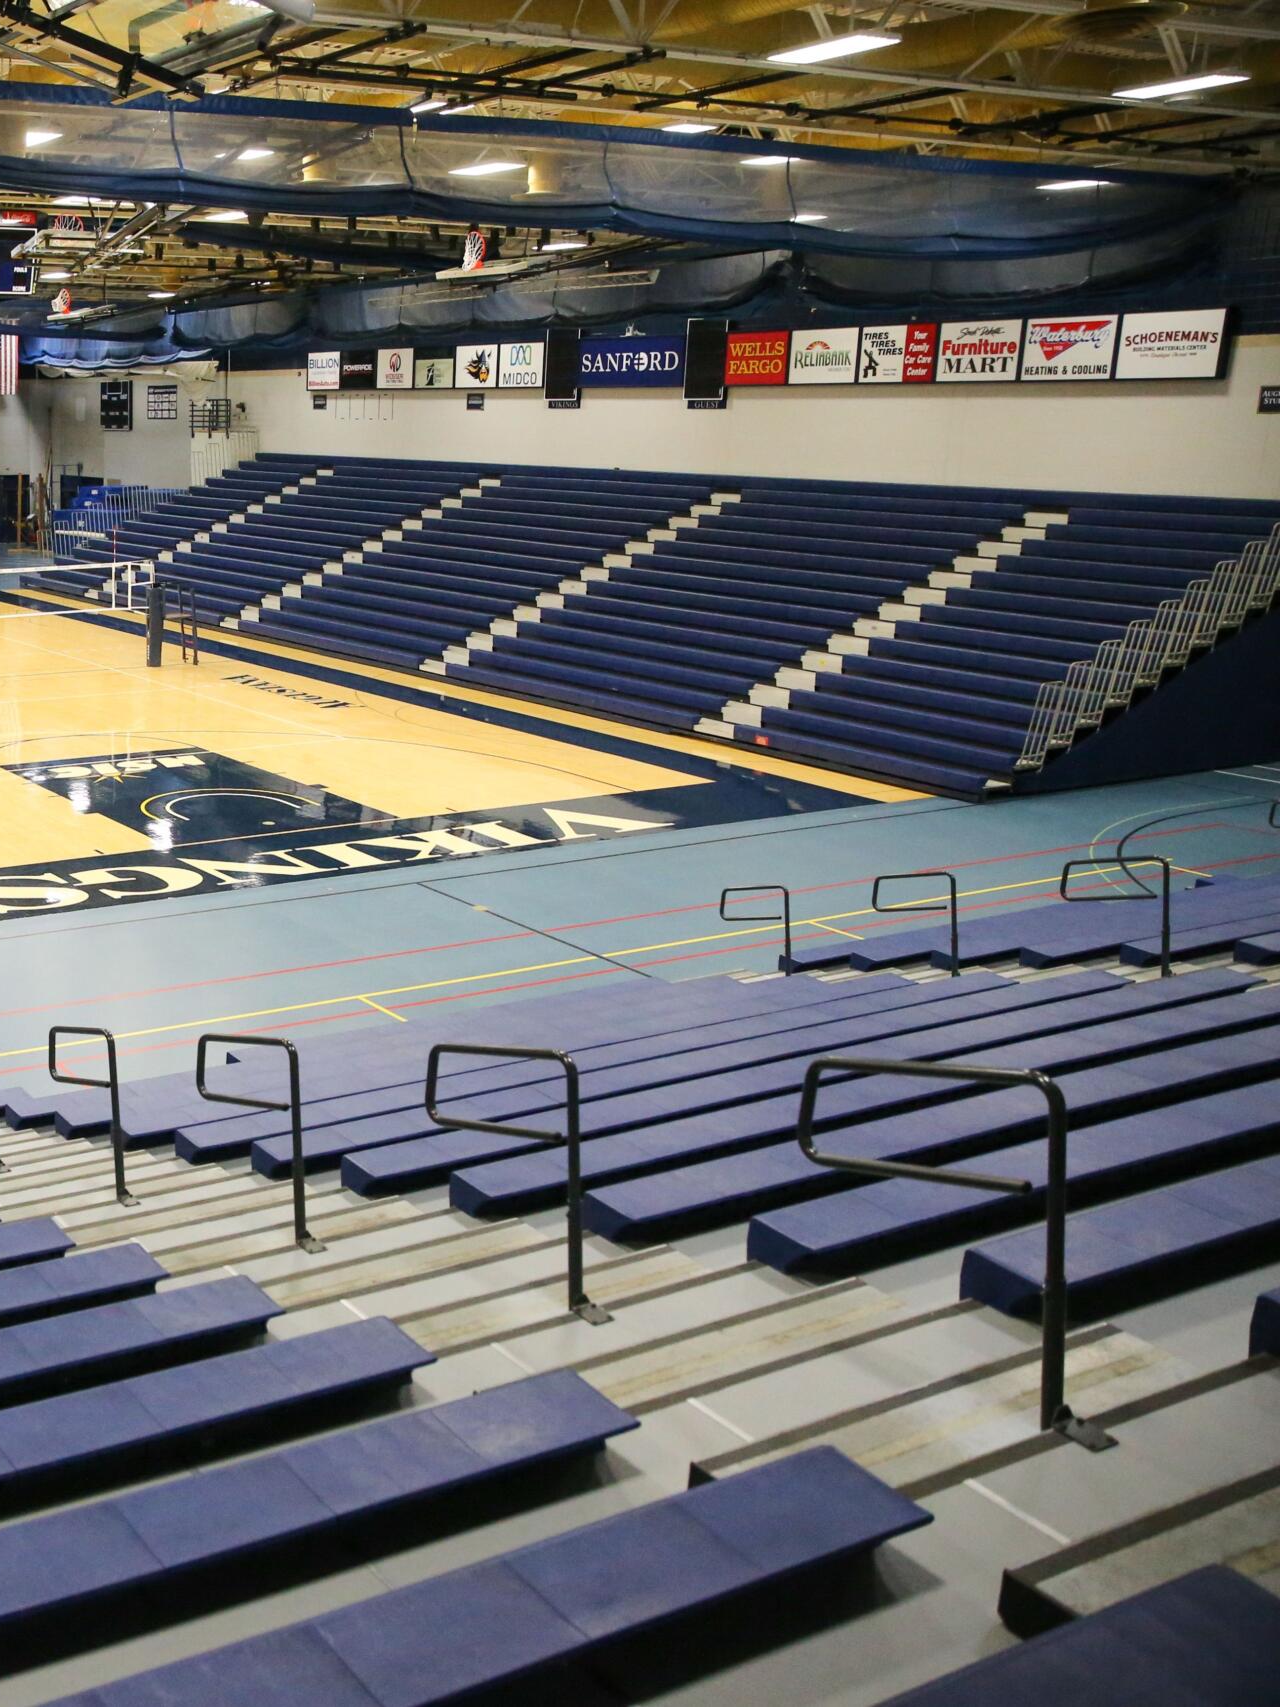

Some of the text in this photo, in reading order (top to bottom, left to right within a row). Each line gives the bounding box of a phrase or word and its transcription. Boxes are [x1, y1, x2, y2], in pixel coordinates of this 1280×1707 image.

[864, 332, 889, 340] TIRES
[913, 330, 929, 340] Your
[1124, 331, 1219, 347] SCHOENEMAN'S
[729, 341, 785, 357] WELLS
[870, 340, 896, 348] TIRES
[908, 343, 930, 353] Family
[941, 338, 1017, 356] Furniture
[877, 347, 903, 356] TIRES
[309, 358, 339, 369] BILLION
[582, 351, 679, 373] SANFORD
[904, 355, 932, 364] Car Care
[728, 359, 782, 375] FARGO
[942, 356, 1014, 374] MART
[1024, 364, 1108, 376] HEATING & COOLING
[906, 367, 928, 376] Center
[502, 372, 537, 385] MIDCO
[551, 401, 579, 409] VIKINGS
[694, 400, 720, 409] GUEST
